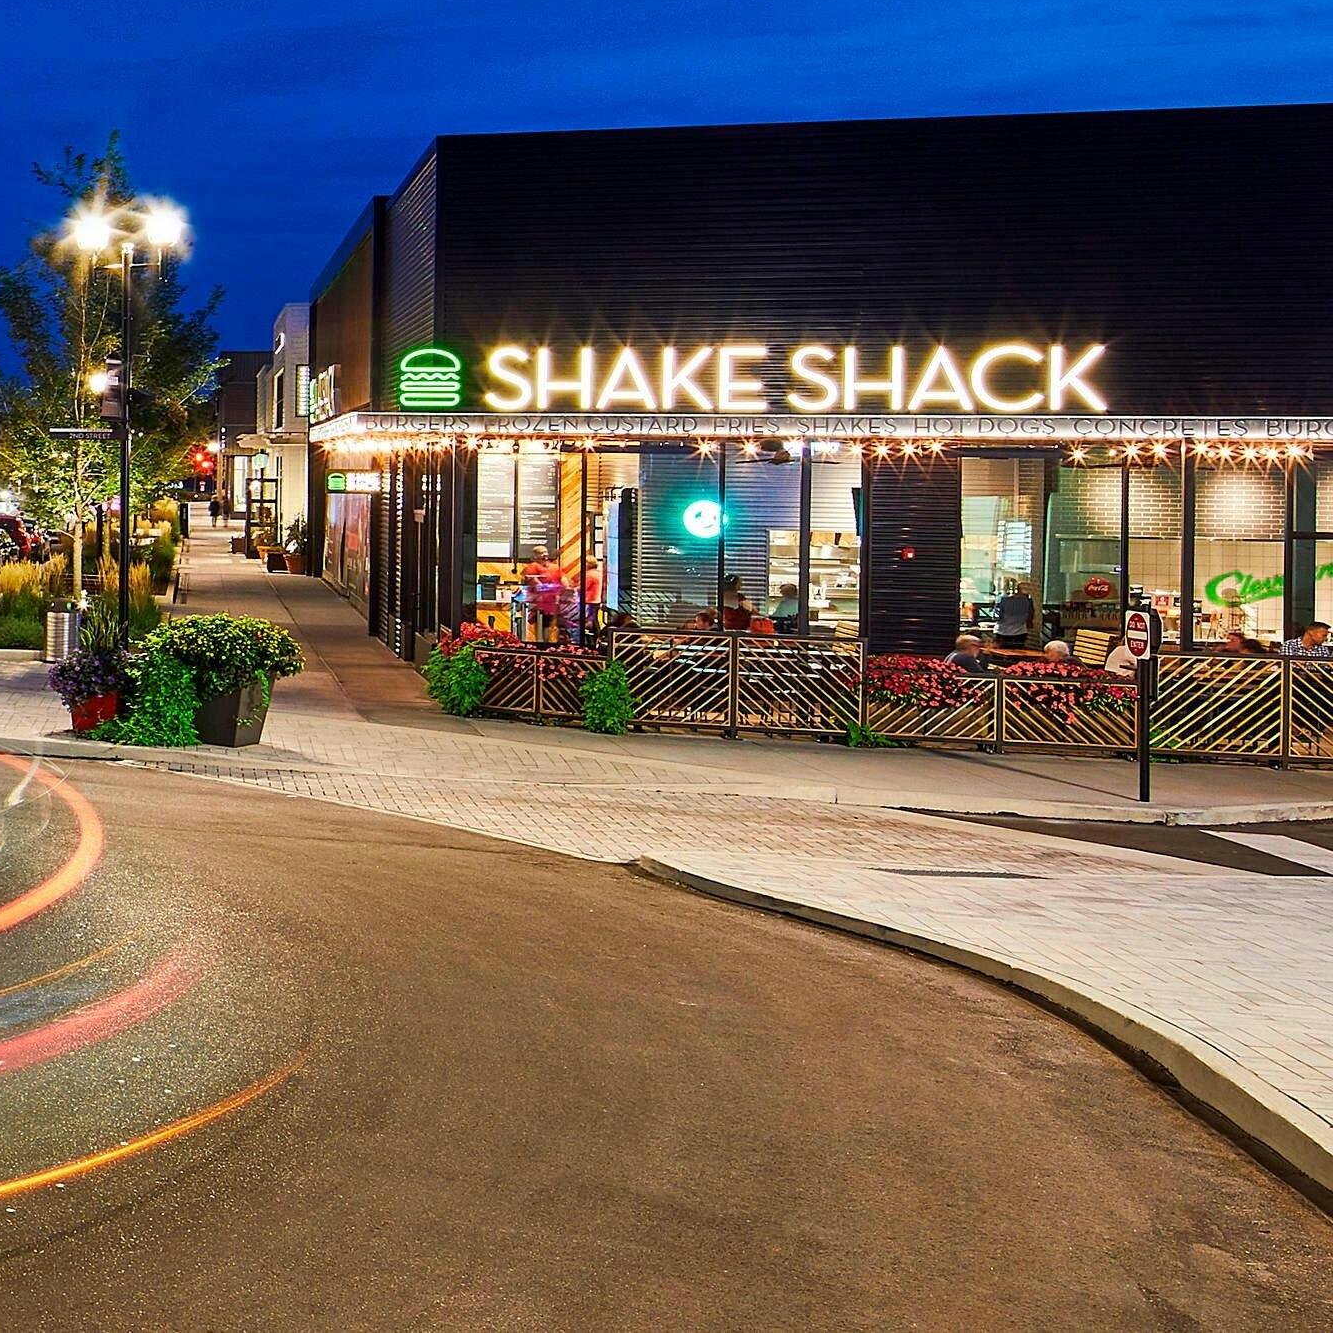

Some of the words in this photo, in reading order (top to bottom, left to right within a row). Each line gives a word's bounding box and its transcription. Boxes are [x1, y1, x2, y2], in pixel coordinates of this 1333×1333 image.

[485, 346, 769, 410] SHAKE
[786, 344, 1109, 412] SHACK
[365, 416, 470, 431] BURGERS
[484, 417, 578, 432] FROZEN
[587, 417, 698, 433] CUSTARD
[714, 417, 780, 433] FRIES
[797, 418, 897, 434] SHAKES
[914, 418, 965, 434] HOT
[978, 418, 1056, 434] DOGS
[1073, 419, 1248, 436] CONCRETES
[1128, 620, 1136, 629] DO
[1136, 621, 1146, 630] NOT
[1130, 640, 1144, 649] ENTER
